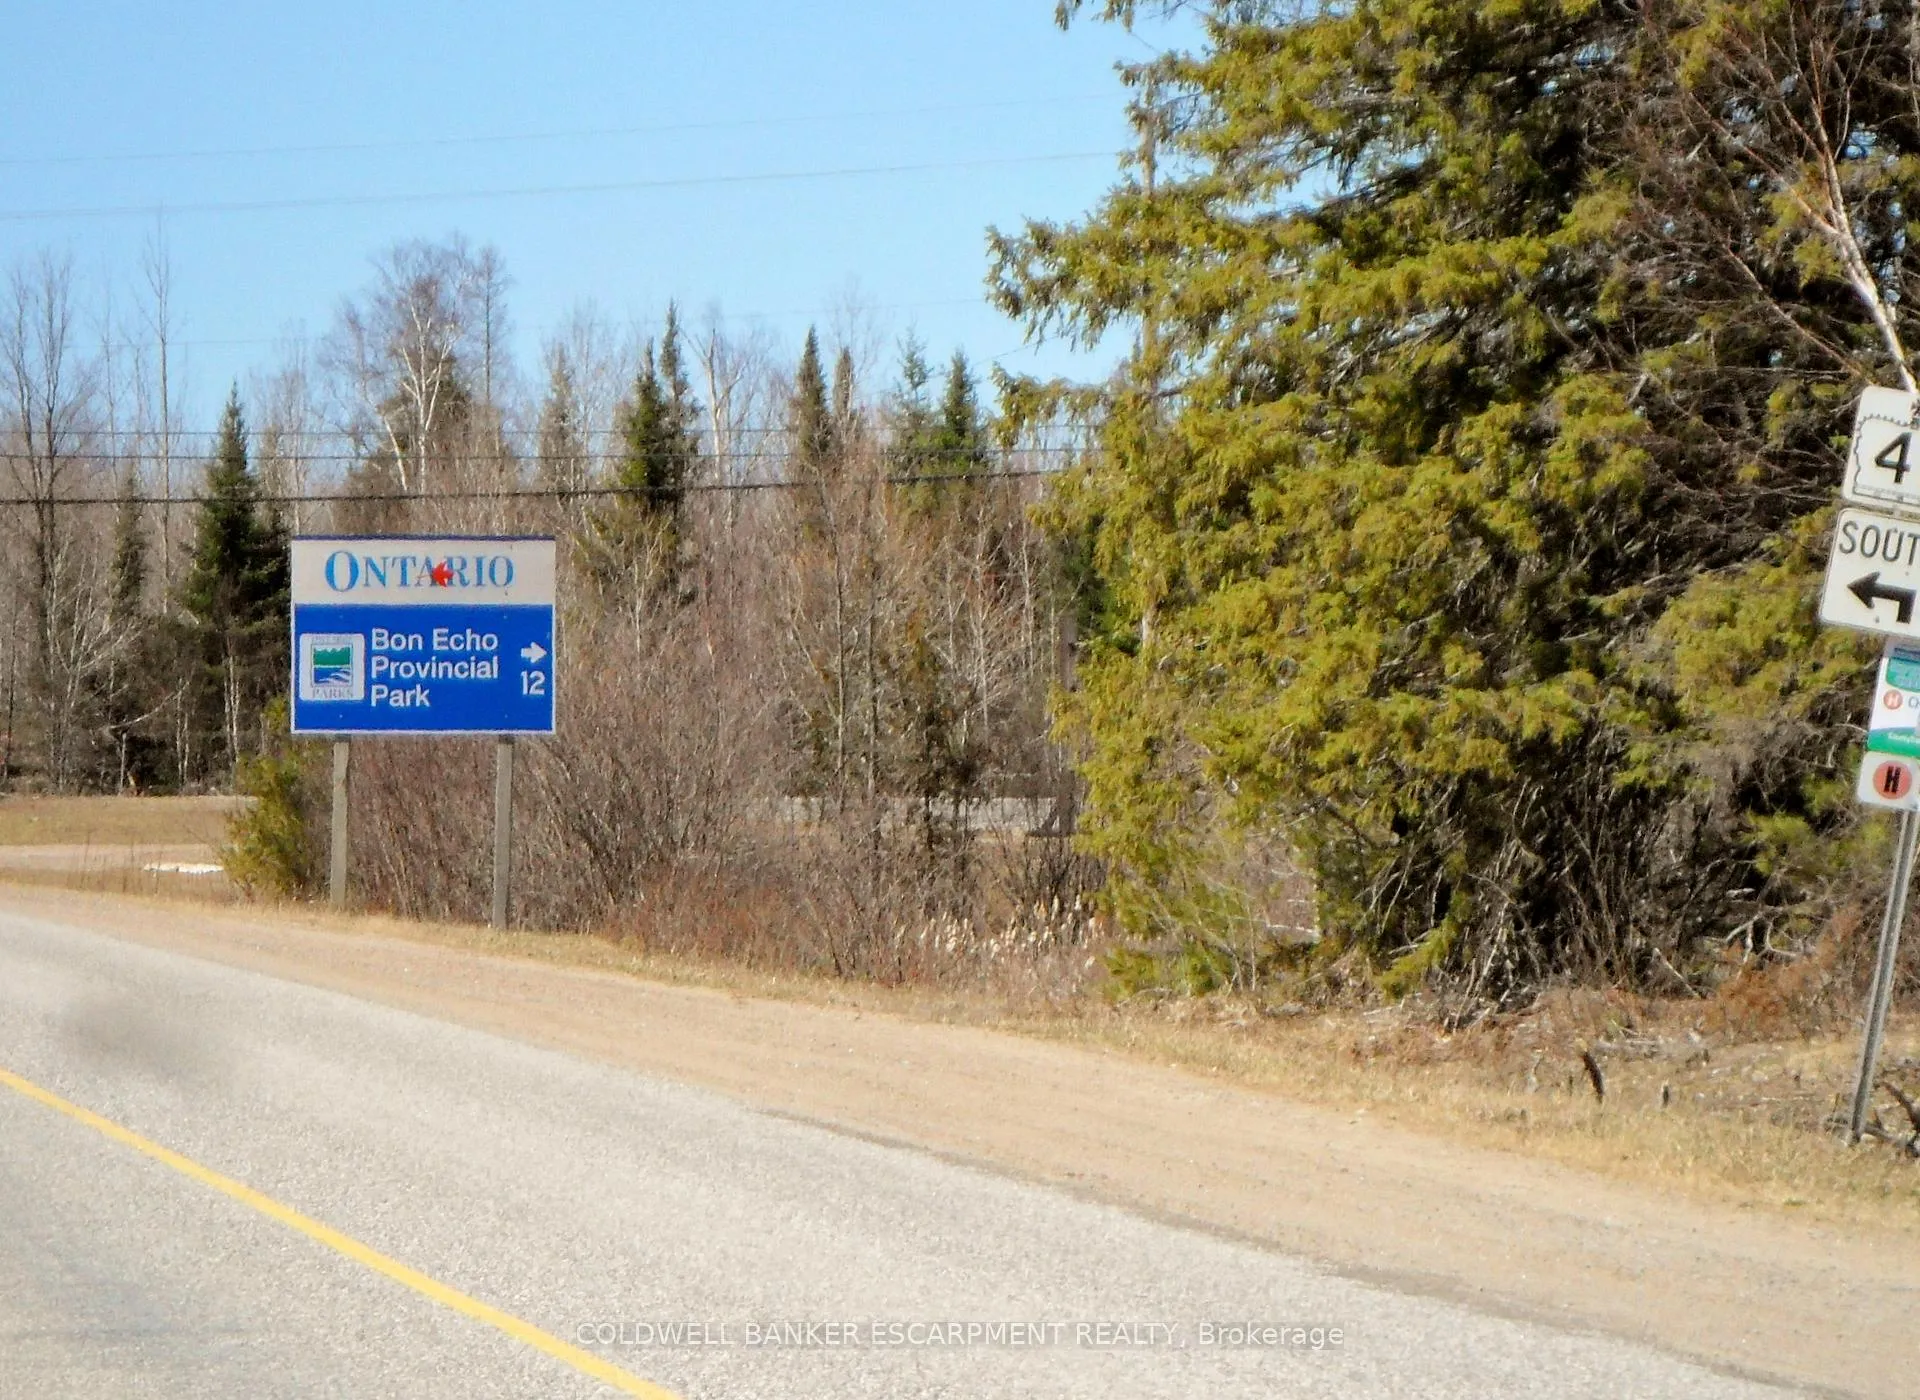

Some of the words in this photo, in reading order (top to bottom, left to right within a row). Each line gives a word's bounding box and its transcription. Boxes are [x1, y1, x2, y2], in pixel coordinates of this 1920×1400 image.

[325, 550, 514, 593] ONTARIO
[371, 628, 423, 651] Bon
[432, 628, 499, 651] Echo
[371, 655, 499, 680] Provincial
[520, 670, 545, 696] 12
[370, 684, 431, 708] Park
[1883, 765, 1901, 794] H
